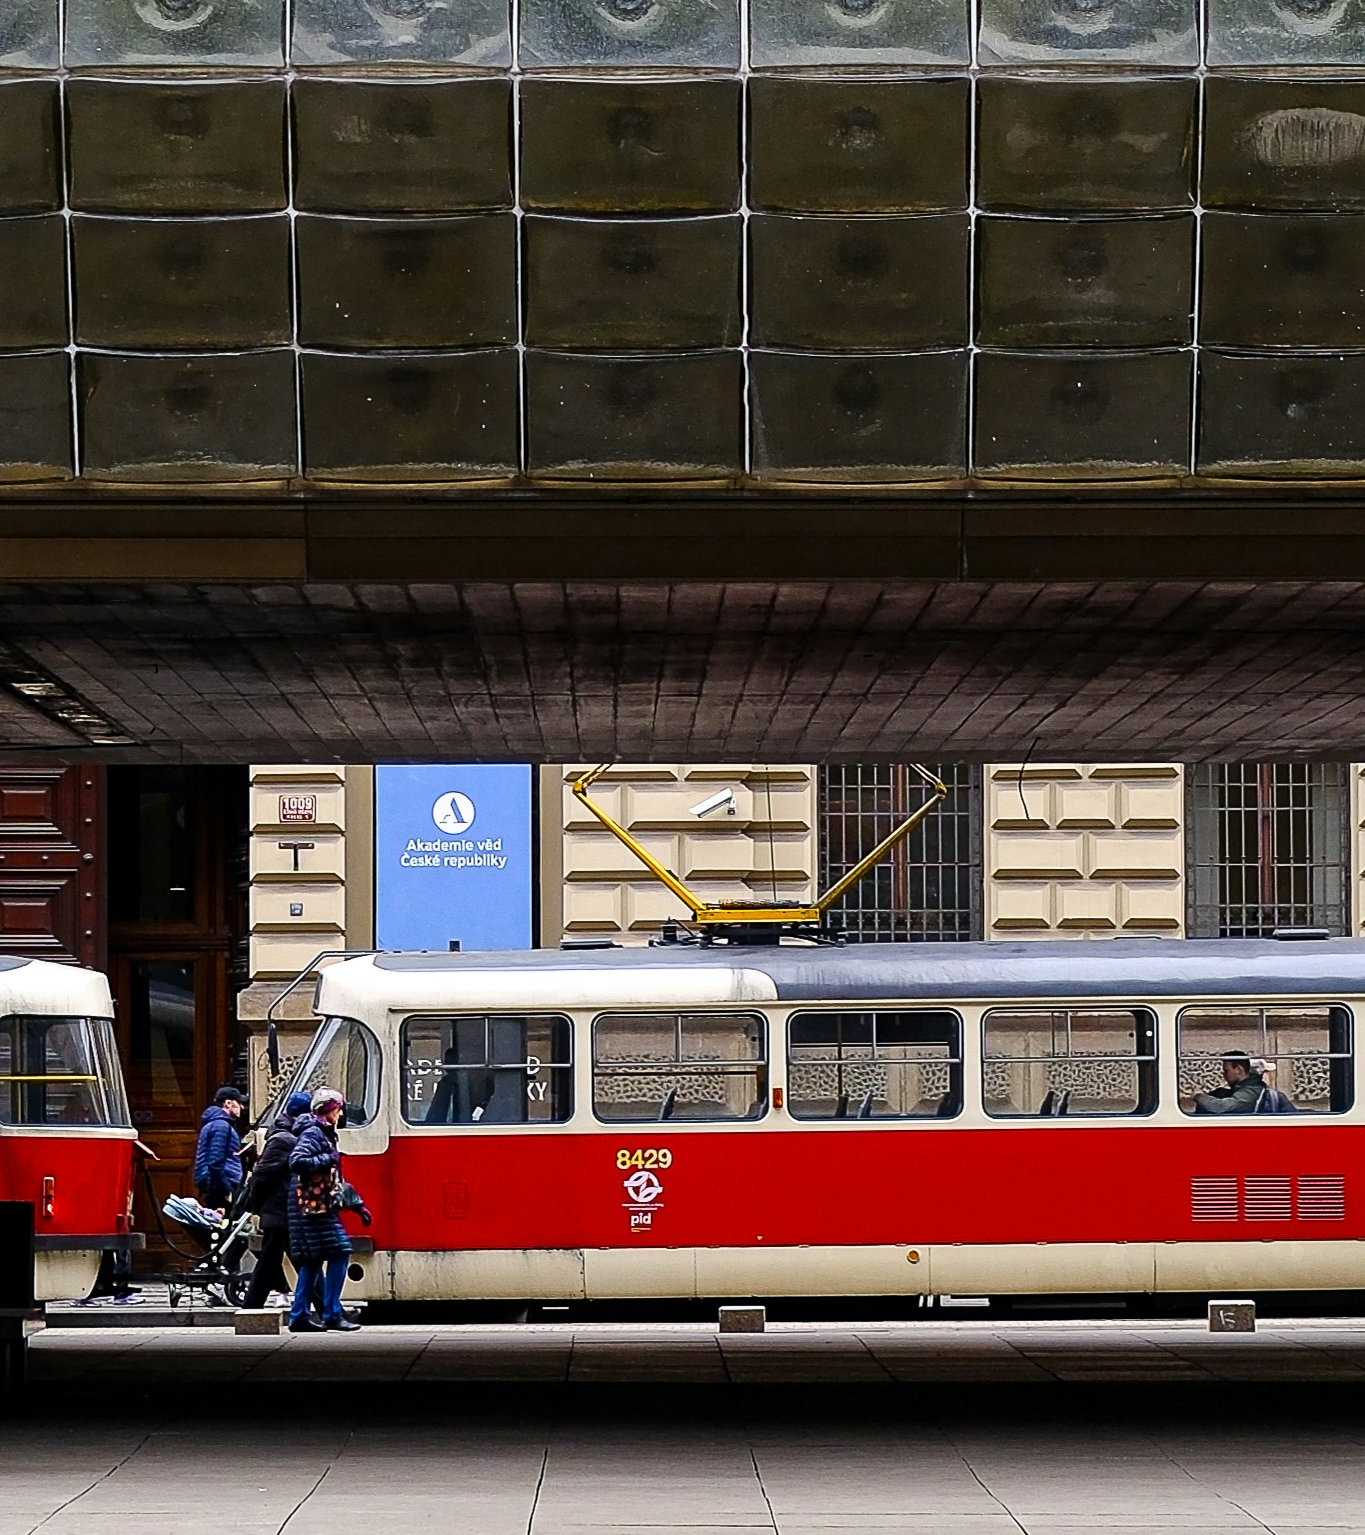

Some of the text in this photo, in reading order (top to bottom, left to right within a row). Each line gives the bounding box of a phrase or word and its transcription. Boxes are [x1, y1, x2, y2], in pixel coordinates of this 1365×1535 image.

[283, 797, 313, 810] 1009
[406, 837, 502, 852] Akademie věd
[400, 851, 508, 869] České republiky
[617, 1148, 673, 1169] 8429
